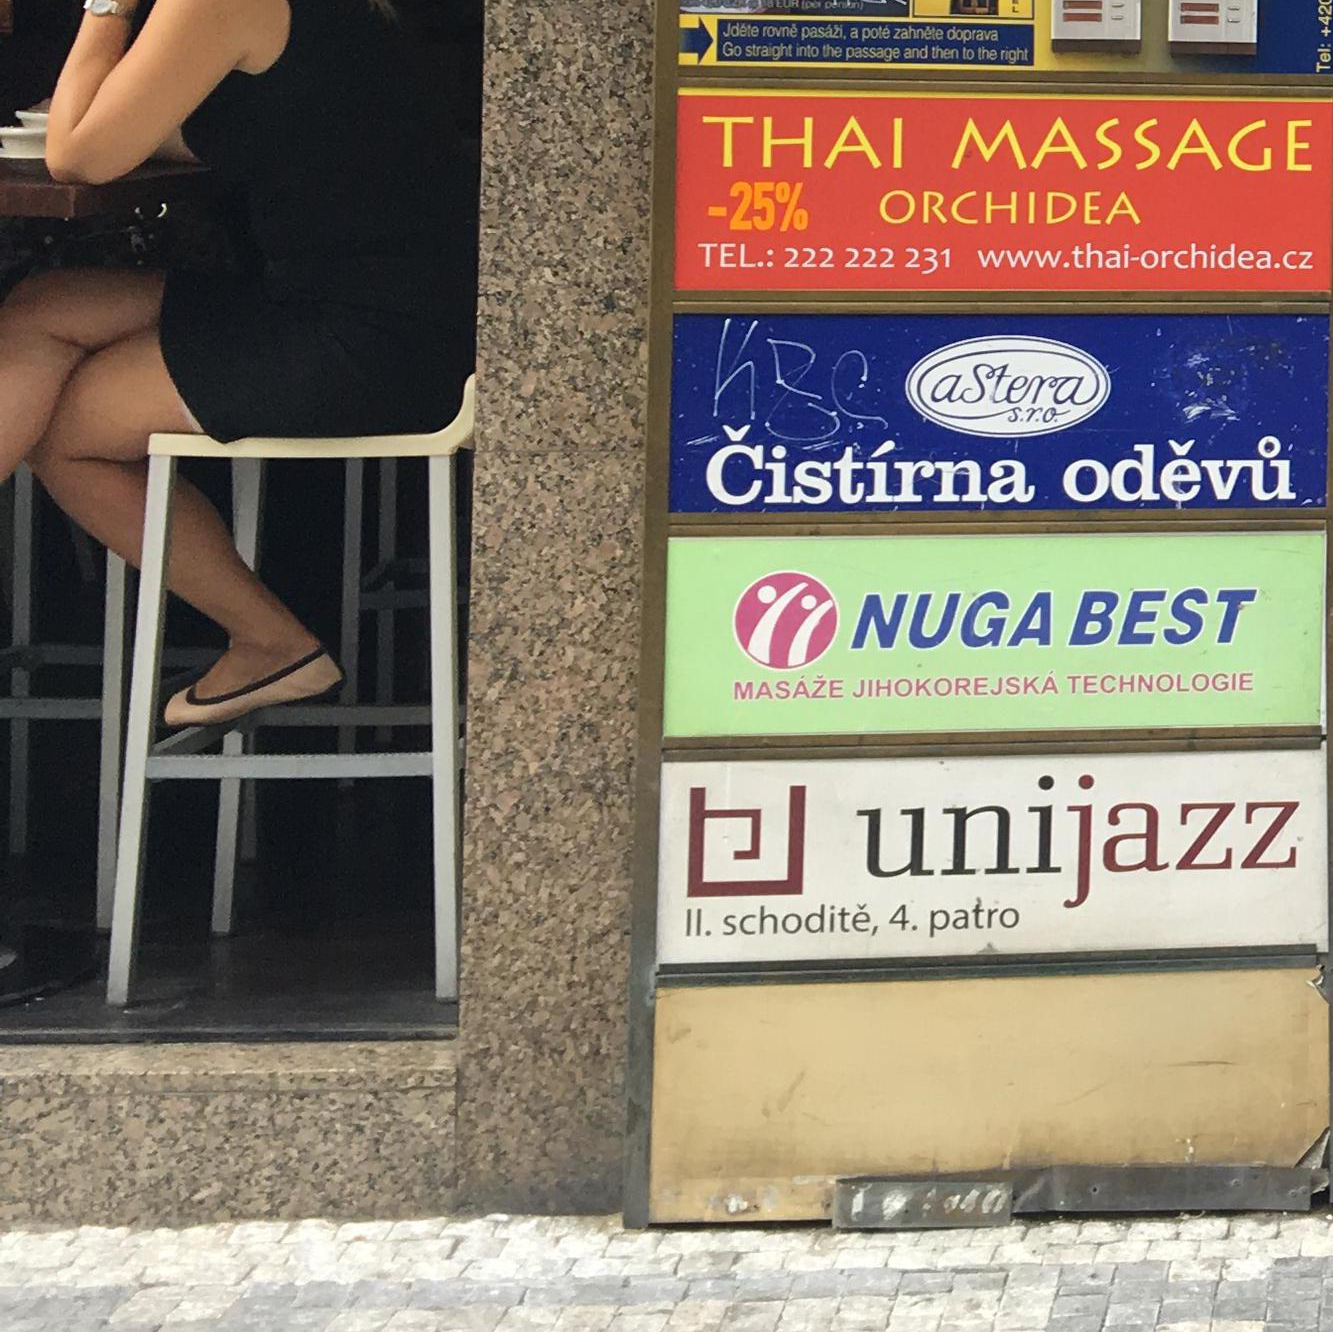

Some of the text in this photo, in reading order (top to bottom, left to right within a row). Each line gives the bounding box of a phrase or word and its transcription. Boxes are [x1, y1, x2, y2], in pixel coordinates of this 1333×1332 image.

[723, 23, 759, 39] Jděte
[762, 25, 798, 39] rovně
[850, 29, 858, 40] a
[861, 26, 890, 42] poté
[893, 27, 944, 41] zahněte
[947, 27, 999, 43] doprava
[722, 42, 1029, 64] Go straight into the passage and then to the right
[1316, 42, 1332, 73] Tel:
[704, 116, 1313, 172] THAI MASSAGE
[708, 181, 809, 231] -25%
[879, 190, 1141, 226] ORCHIDEA
[698, 243, 1314, 276] TEL.: 222 222 231 www.thai-orchidea.cz
[1008, 406, 1070, 423] s.r.o.
[706, 425, 1296, 505] Čistírna oděvů
[851, 587, 1258, 650] NUGA BEST
[734, 670, 1254, 700] MASÁŽE JIHOKOREJSKÁ TECHNOLOGIE
[857, 774, 1300, 909] unijazz
[721, 902, 879, 937] schoditě,
[888, 902, 918, 932] 4.
[928, 901, 1021, 932] patro
